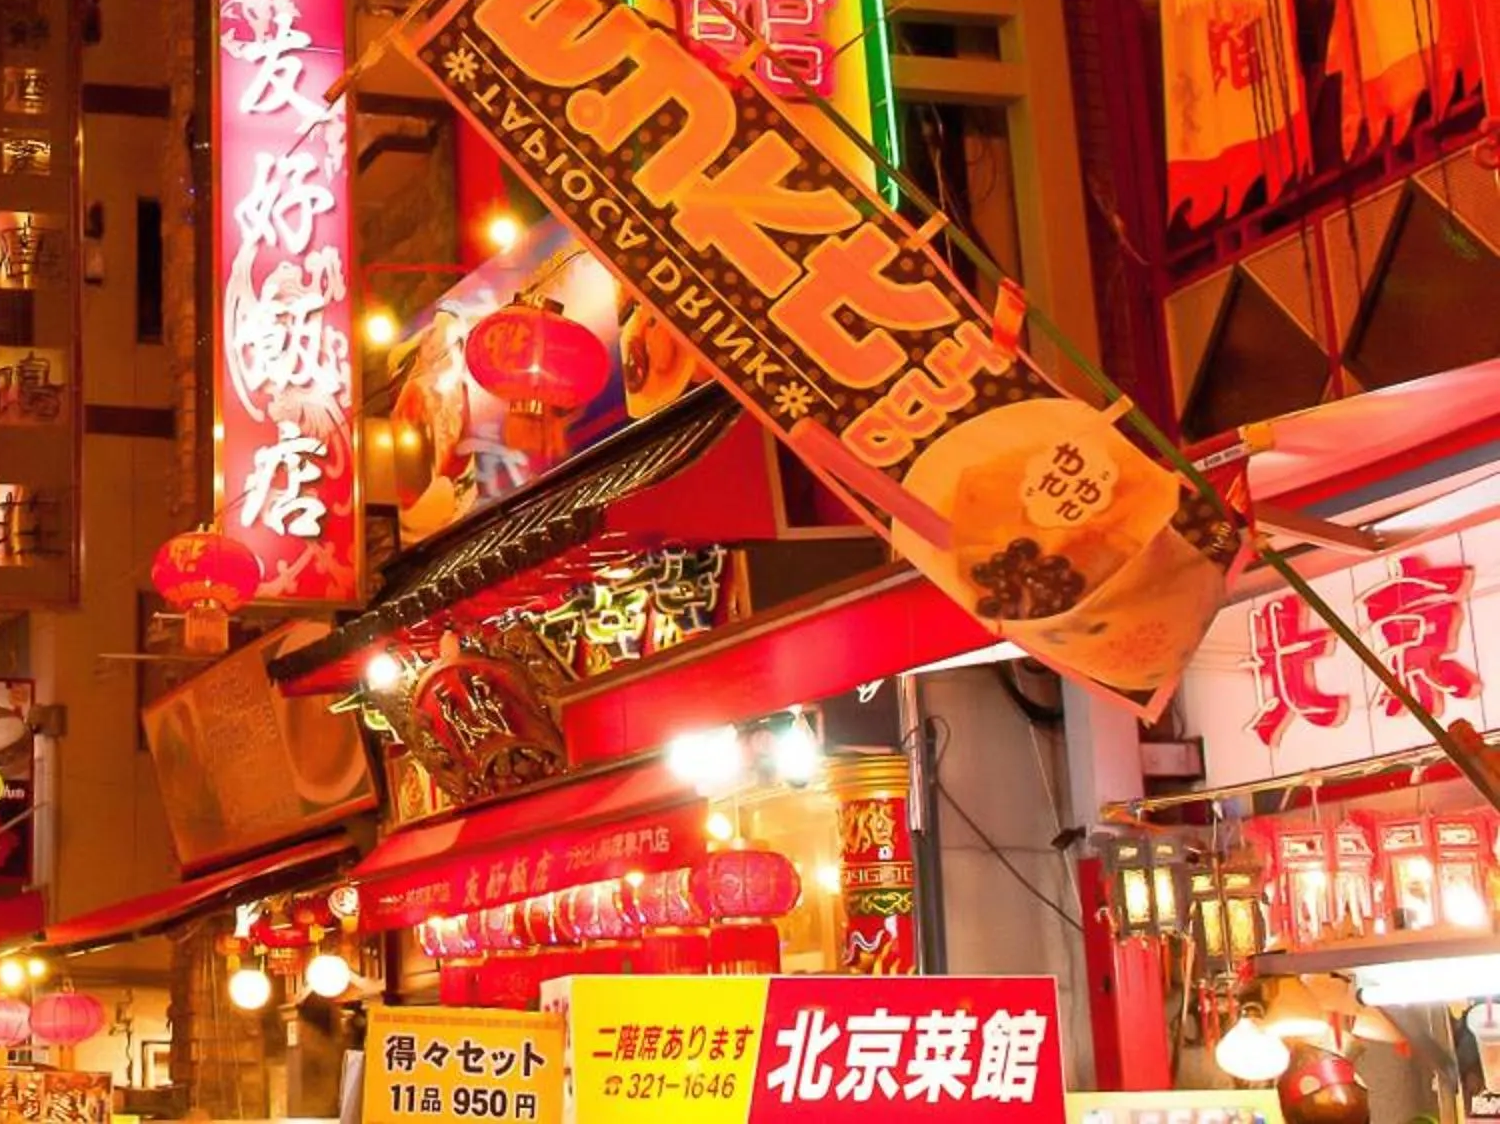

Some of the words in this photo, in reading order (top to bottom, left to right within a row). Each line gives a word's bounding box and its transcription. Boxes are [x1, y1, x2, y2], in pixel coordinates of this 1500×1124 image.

[237, 13, 337, 540] 友好飯店
[1243, 554, 1483, 750] 北京
[386, 1034, 546, 1078] 得々セット
[592, 1025, 755, 1061] 二階席あります
[767, 1008, 1050, 1105] 北京菜館
[626, 1072, 737, 1099] 321-1646
